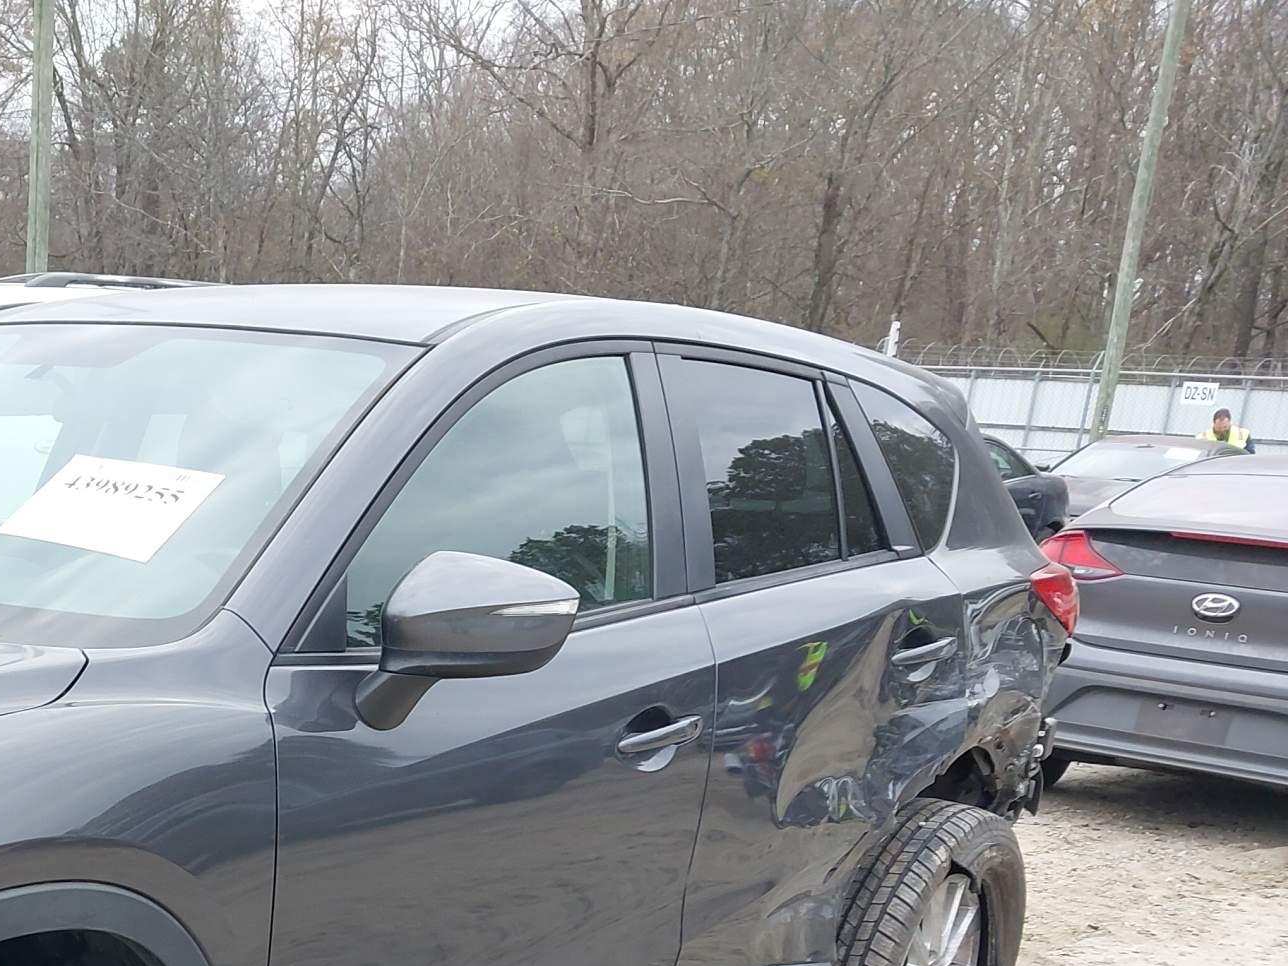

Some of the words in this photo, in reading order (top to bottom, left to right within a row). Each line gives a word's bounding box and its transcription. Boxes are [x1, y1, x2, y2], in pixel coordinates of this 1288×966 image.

[1184, 385, 1216, 401] DZ-SN
[64, 475, 186, 505] 43989255
[1173, 624, 1248, 643] IONIQ
